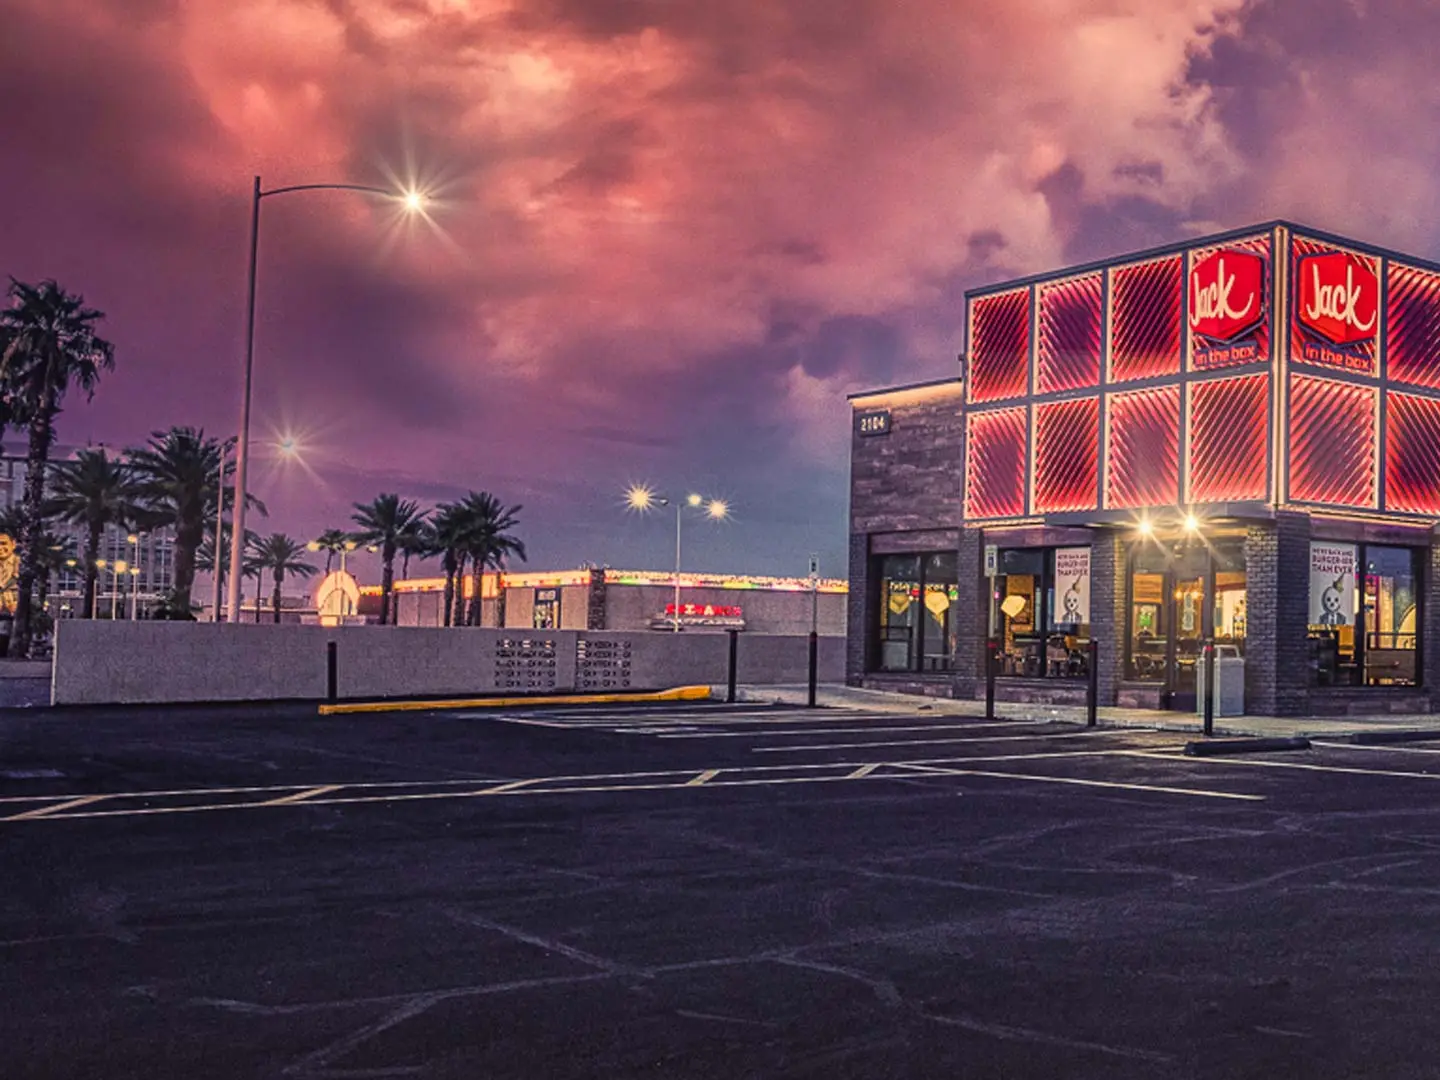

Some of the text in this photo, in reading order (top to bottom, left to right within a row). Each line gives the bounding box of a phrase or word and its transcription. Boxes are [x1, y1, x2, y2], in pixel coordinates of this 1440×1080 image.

[1190, 258, 1254, 327] Jack
[1306, 263, 1376, 331] Jack
[1196, 346, 1255, 365] in the box
[1305, 347, 1369, 370] in the box
[860, 416, 885, 432] 2104
[1312, 563, 1334, 573] THAN
